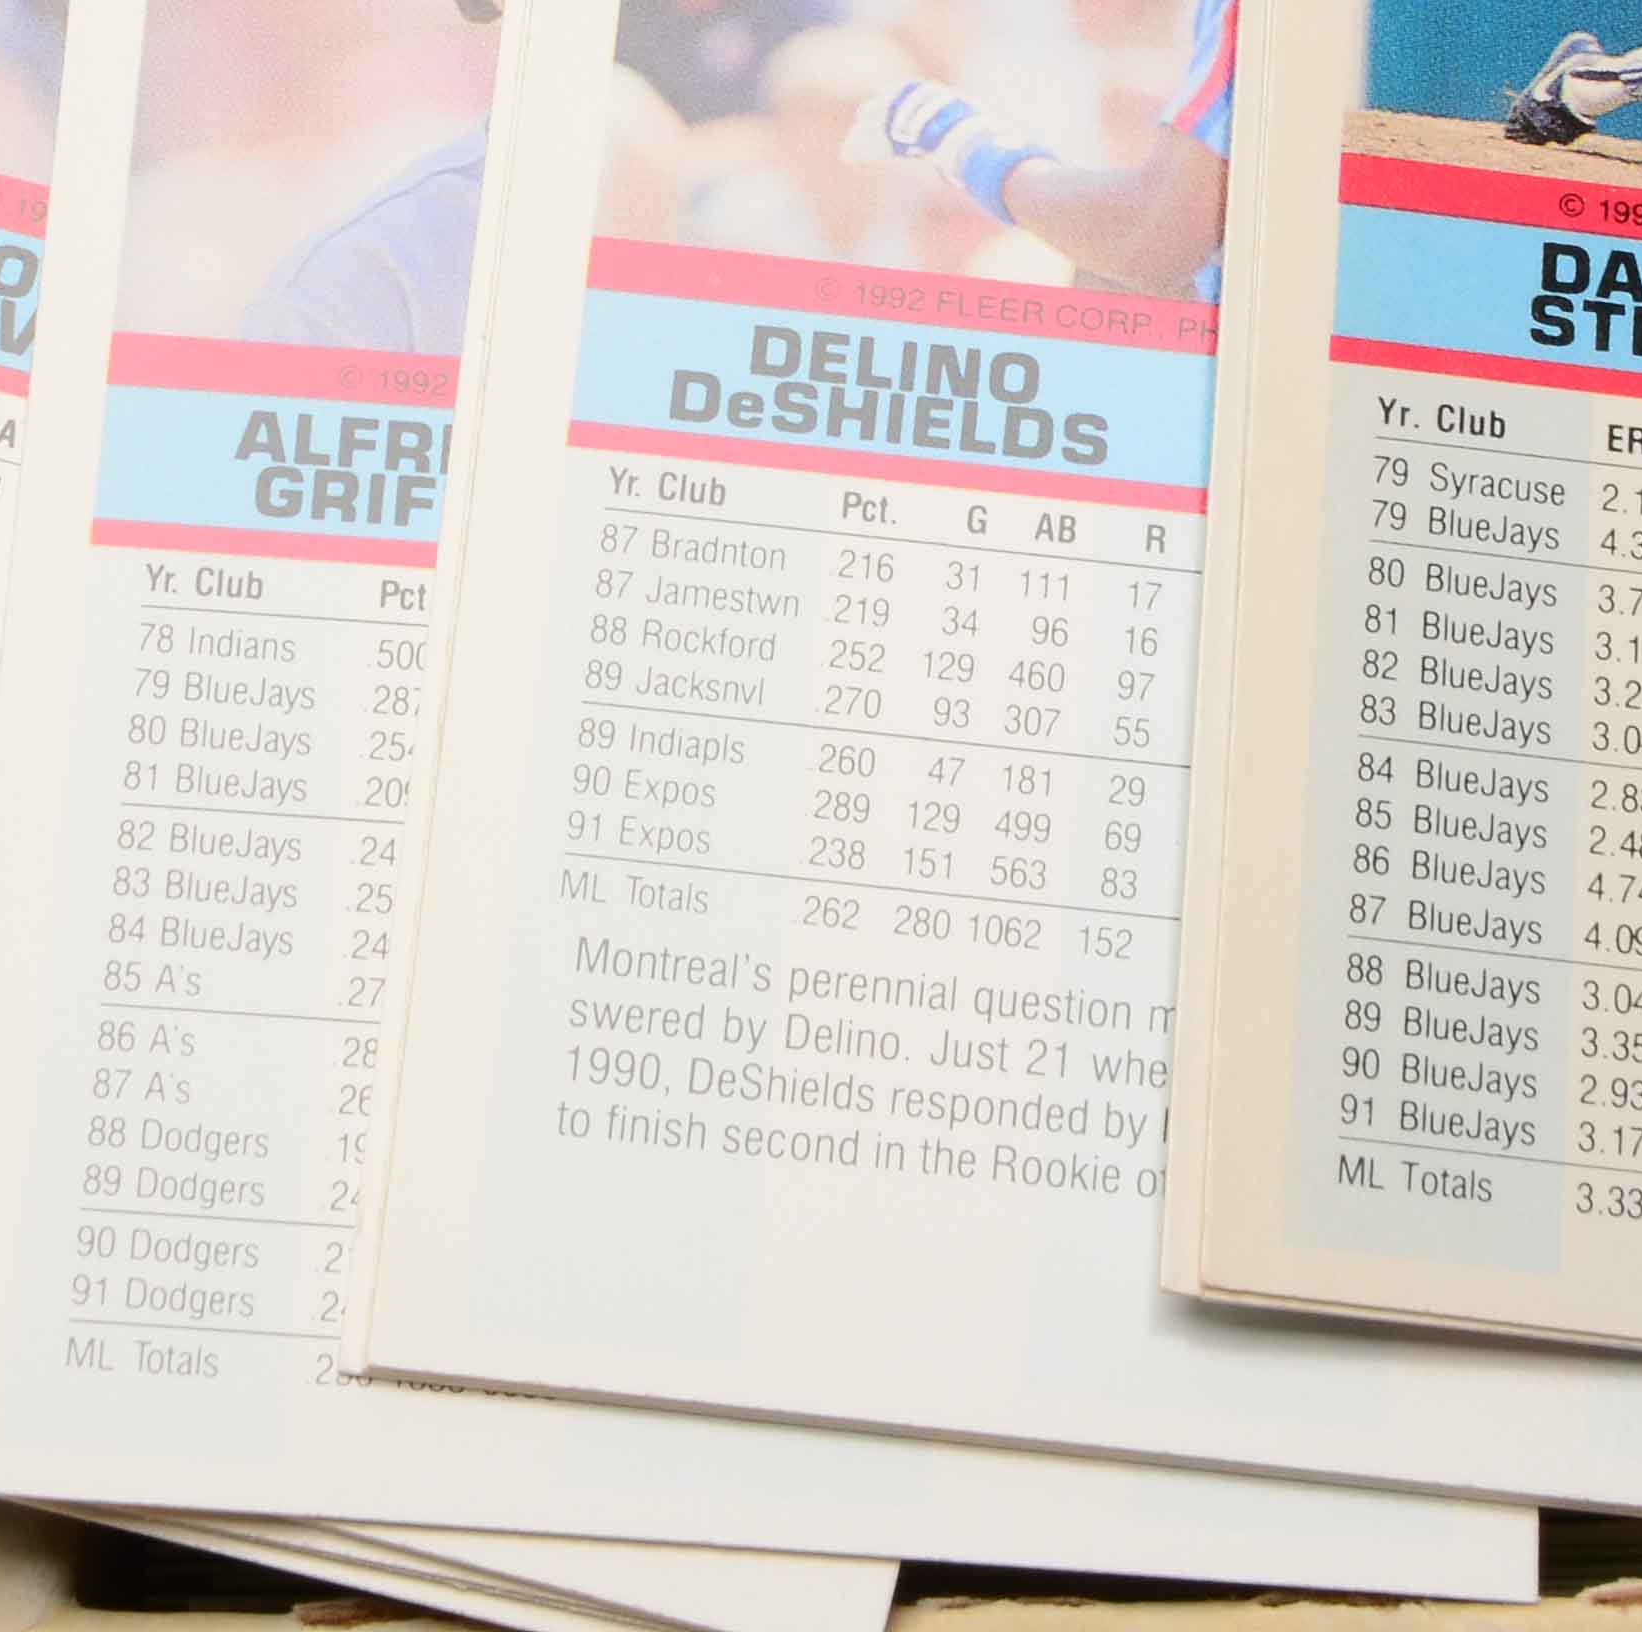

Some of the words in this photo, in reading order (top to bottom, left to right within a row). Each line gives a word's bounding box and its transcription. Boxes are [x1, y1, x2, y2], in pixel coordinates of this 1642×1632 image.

[856, 282, 927, 314] 1992
[935, 288, 1046, 325] FLEER
[749, 323, 1041, 413] DELINO
[668, 368, 1109, 467] DeSHIELDS
[1375, 393, 1421, 430] Yr.
[1433, 401, 1508, 441] Club
[1371, 452, 1410, 488] 79
[1427, 459, 1567, 508] Syracuse
[593, 566, 635, 600] 87
[643, 574, 801, 619] Jamestwn
[138, 620, 175, 655] 78
[187, 624, 297, 664] Indians
[588, 611, 628, 647] 88
[639, 616, 778, 663] Rockford
[558, 867, 607, 905] ML
[625, 872, 710, 915] Totals
[573, 934, 773, 994] Montreal's
[786, 965, 959, 1013] perennial
[971, 984, 1133, 1032] question
[95, 1017, 136, 1054] 86
[147, 1022, 196, 1058] A's
[567, 996, 706, 1041] swered
[721, 1004, 768, 1056] by
[783, 1011, 910, 1064] Delino.
[927, 1027, 1010, 1075] Just
[1023, 1036, 1069, 1080] 21
[565, 1042, 671, 1098] 1990,
[686, 1055, 875, 1114] DeShields
[888, 1085, 1090, 1137] responded
[1102, 1099, 1149, 1151] by
[555, 1099, 592, 1140] to
[605, 1102, 708, 1152] finish
[720, 1122, 861, 1168] second
[873, 1139, 906, 1172] in
[917, 1135, 977, 1180] the
[990, 1142, 1122, 1196] Rookie
[1335, 1151, 1386, 1192] ML
[1399, 1158, 1494, 1205] Totals
[69, 1271, 108, 1307] 91
[123, 1274, 256, 1322] Dodgers
